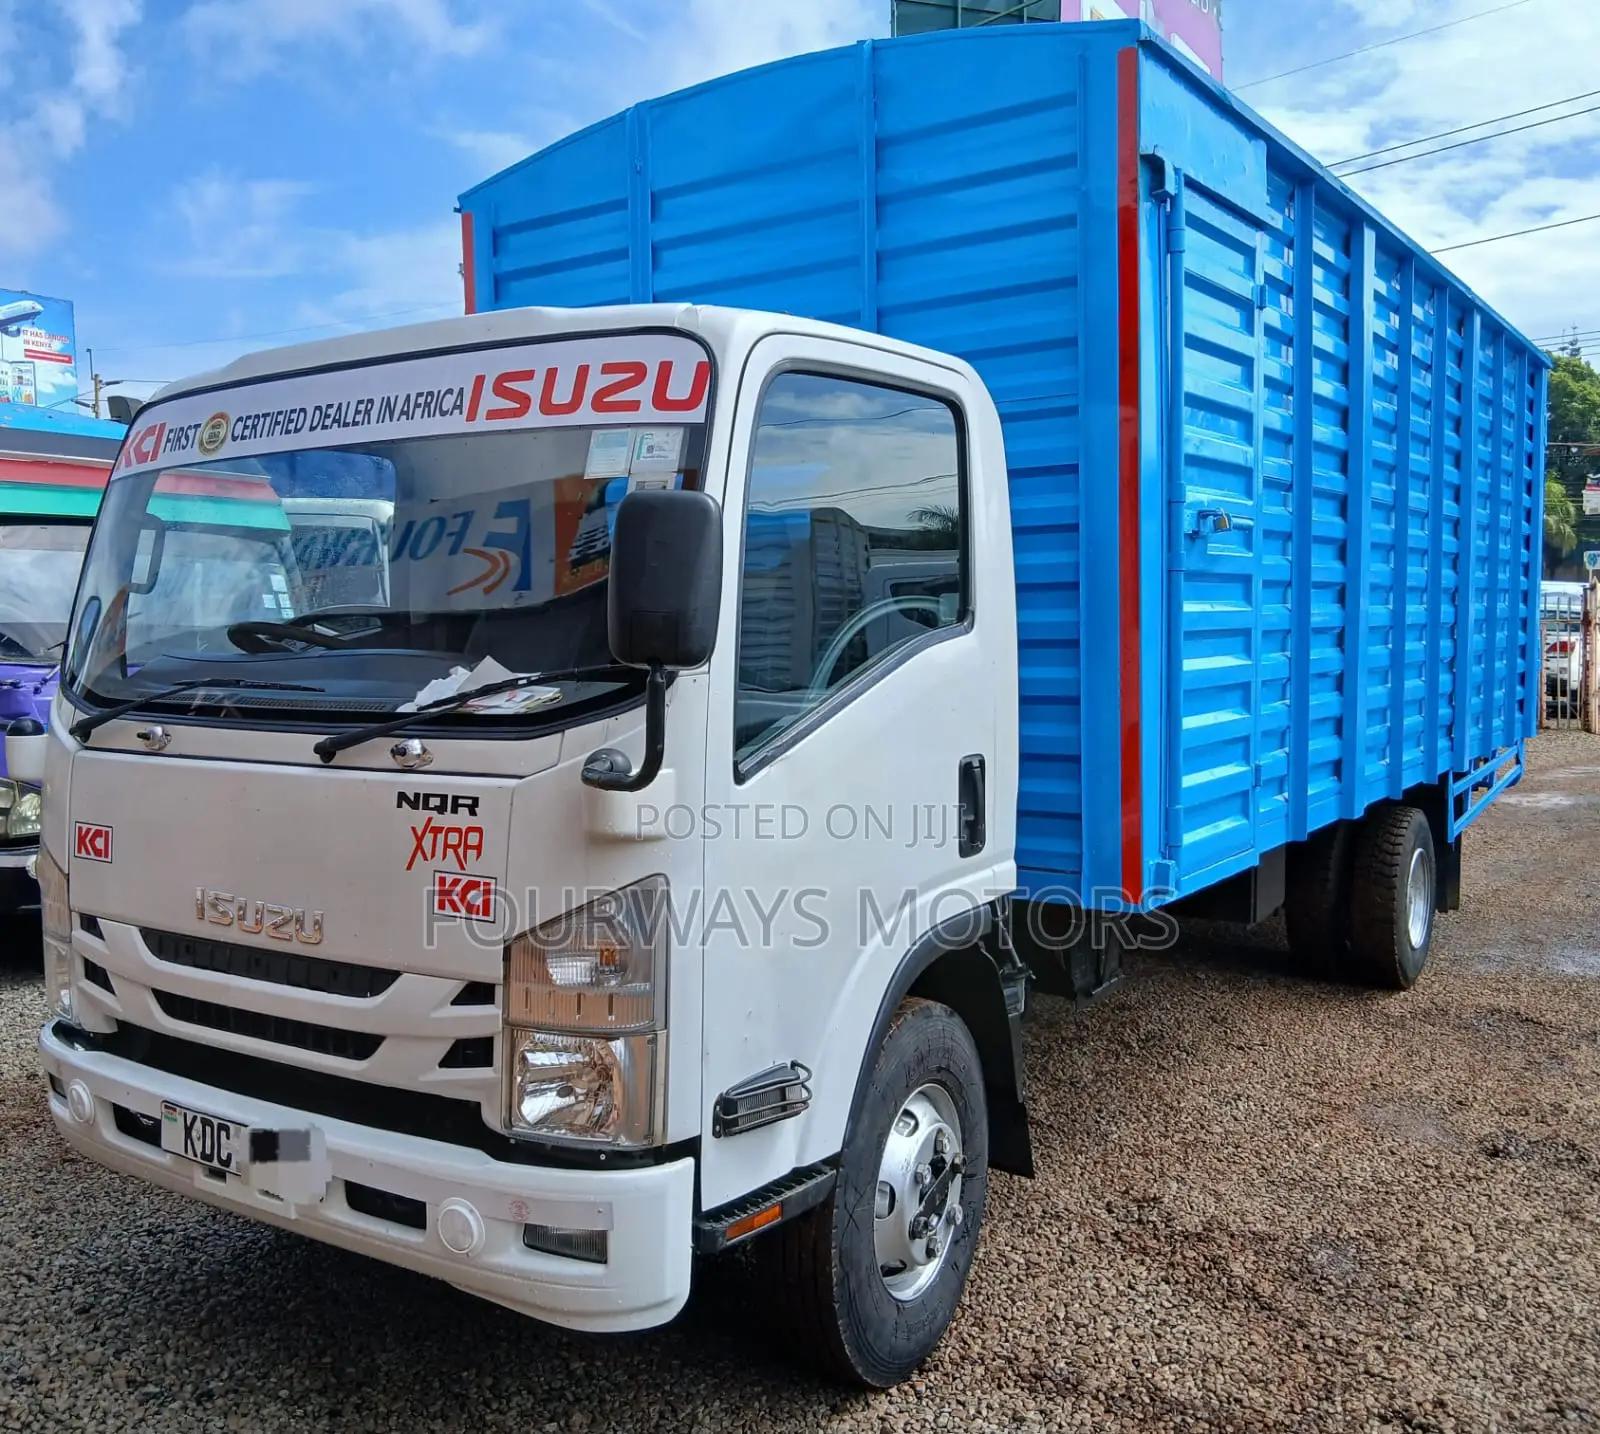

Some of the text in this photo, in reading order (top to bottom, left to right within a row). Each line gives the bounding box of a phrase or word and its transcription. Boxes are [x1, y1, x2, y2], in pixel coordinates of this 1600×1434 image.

[117, 422, 167, 472] KCI
[163, 423, 202, 453] FIRST
[231, 407, 308, 442] CERTIFIED
[309, 398, 374, 432] DEALER
[376, 395, 399, 423] IN
[398, 387, 465, 421] AFRICA
[465, 360, 711, 422] ISUZU
[396, 791, 480, 817] NQR
[76, 825, 110, 859] KCI
[406, 816, 484, 871] XTRA
[195, 886, 325, 945] ISUZU
[437, 875, 492, 917] KCI
[183, 1111, 233, 1168] KDC
